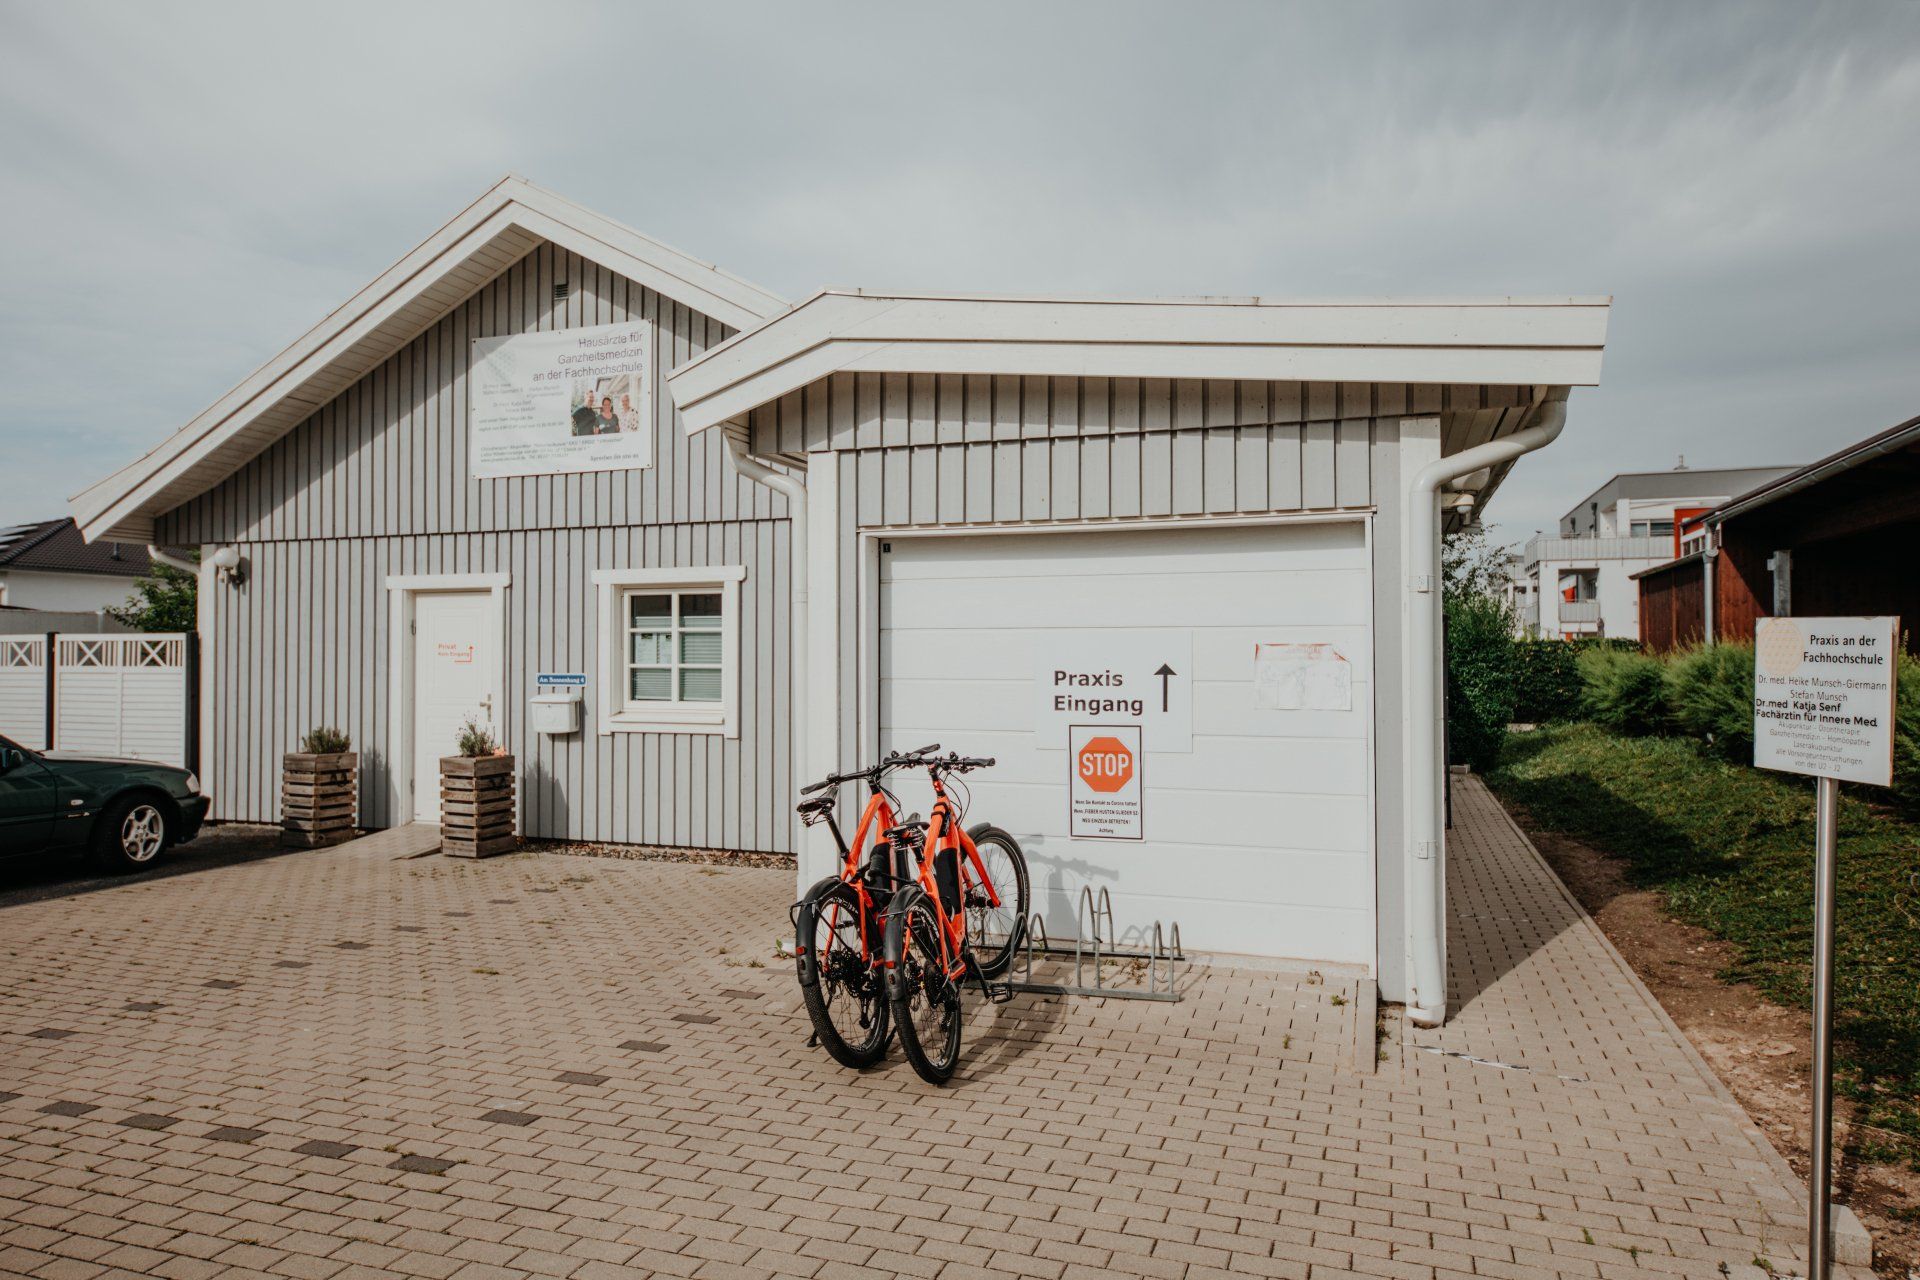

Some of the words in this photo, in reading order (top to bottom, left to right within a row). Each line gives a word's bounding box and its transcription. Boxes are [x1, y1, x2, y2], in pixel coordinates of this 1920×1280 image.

[579, 335, 626, 348] Hausärzte
[629, 331, 643, 343] für
[558, 348, 643, 364] Ganzheitsmedizin
[533, 373, 545, 382] an
[547, 370, 562, 380] der
[565, 362, 643, 378] Fachhochschule
[438, 642, 456, 650] Privat
[1810, 635, 1839, 646] Praxis
[1843, 637, 1855, 646] an
[1859, 635, 1876, 646] der
[1803, 652, 1883, 664] Fachhochschule
[1054, 670, 1123, 687] Praxis
[1758, 675, 1768, 684] Dr.
[1770, 676, 1785, 685] med.
[1788, 678, 1809, 686] Heike
[1811, 677, 1887, 690] Munsch-Giermann
[1790, 690, 1815, 700] Stefan
[1817, 691, 1848, 702] Munsch
[1054, 695, 1143, 716] Eingang
[1793, 700, 1816, 712] Katja
[1819, 702, 1842, 712] Senf
[1756, 709, 1801, 720] Fachärztin
[1804, 711, 1817, 722] für
[1819, 714, 1851, 725] Innere
[1778, 721, 1812, 730] Akupunktur
[1818, 725, 1860, 736] Ozontherapie
[1769, 729, 1821, 741] Ganzheitsmedizin
[1827, 735, 1871, 747] Homöopathie
[1793, 741, 1843, 753] Laserakupunktur
[1082, 752, 1130, 777] STOP
[1787, 749, 1863, 766] Vorsorgeuntersuchungen
[1807, 760, 1817, 769] der
